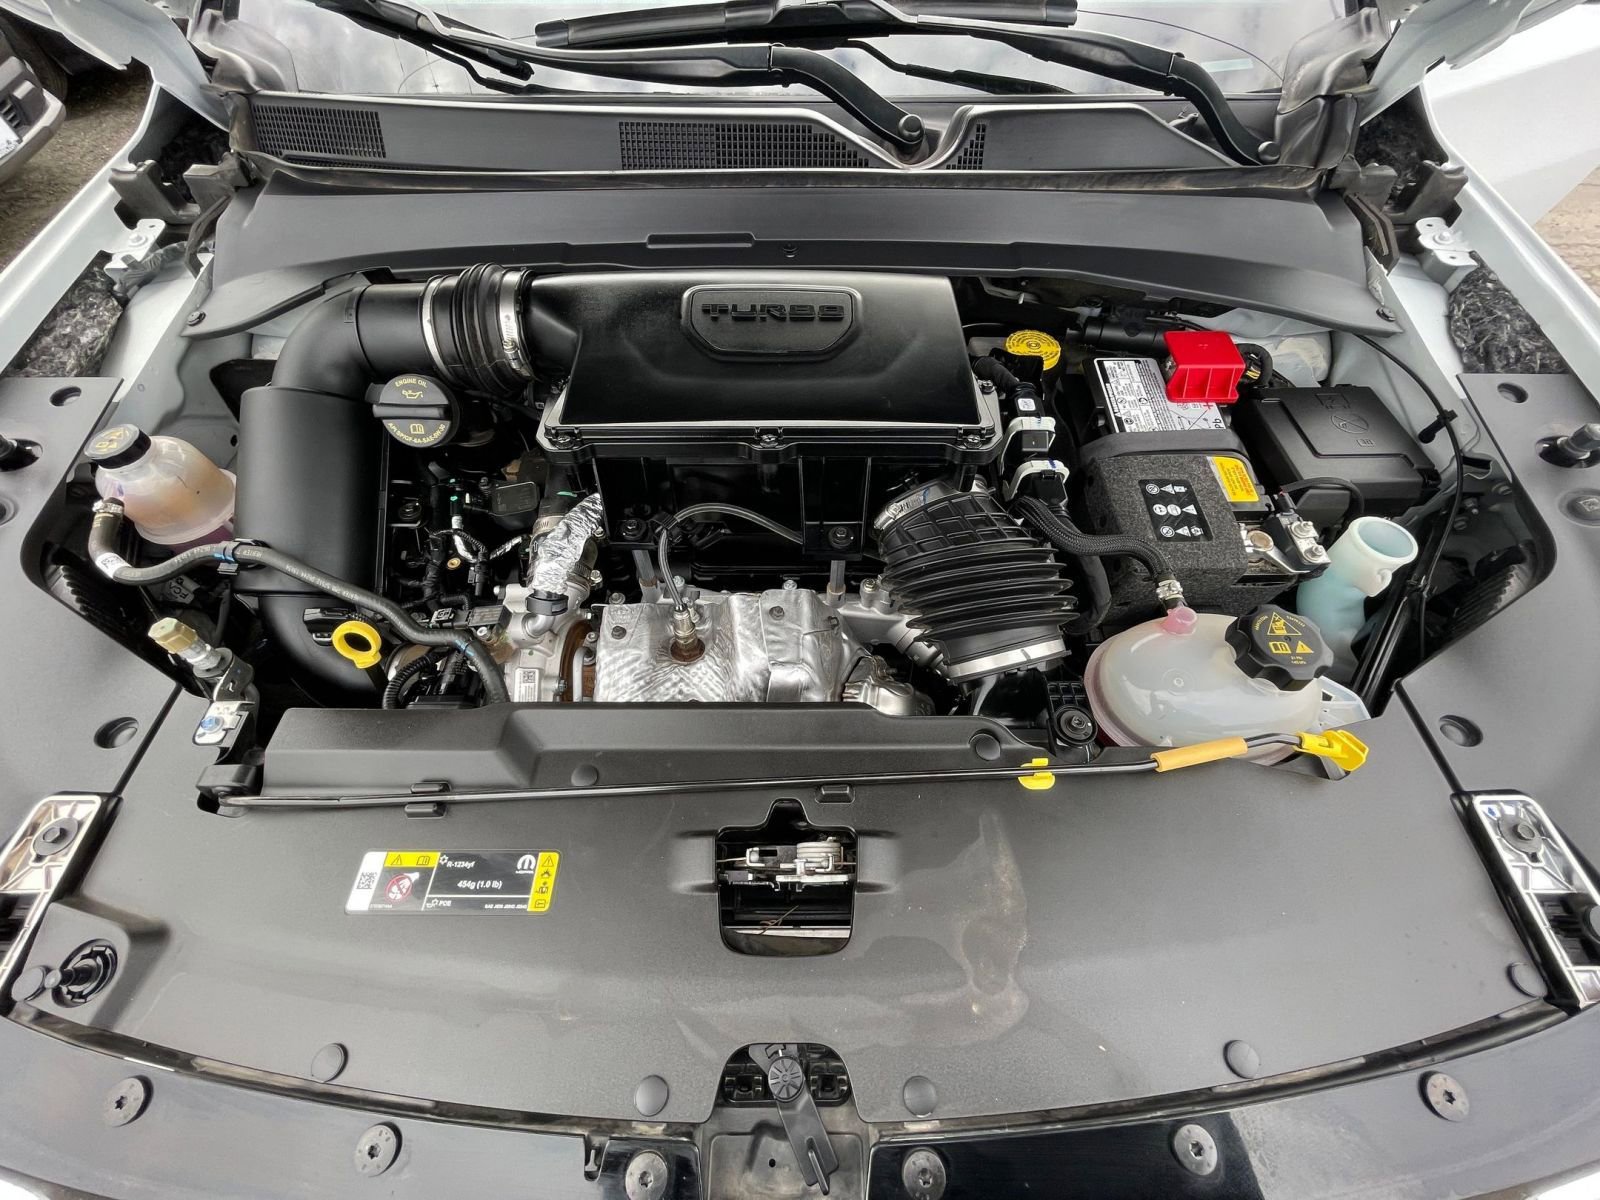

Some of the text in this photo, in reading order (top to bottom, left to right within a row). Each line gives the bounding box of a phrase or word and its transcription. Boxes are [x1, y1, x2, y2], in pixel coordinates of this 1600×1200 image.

[702, 303, 845, 321] TURBO
[395, 378, 428, 388] ENGINE OIL
[446, 860, 475, 869] R-1234yf
[457, 880, 503, 890] 454g (1.0 lb)
